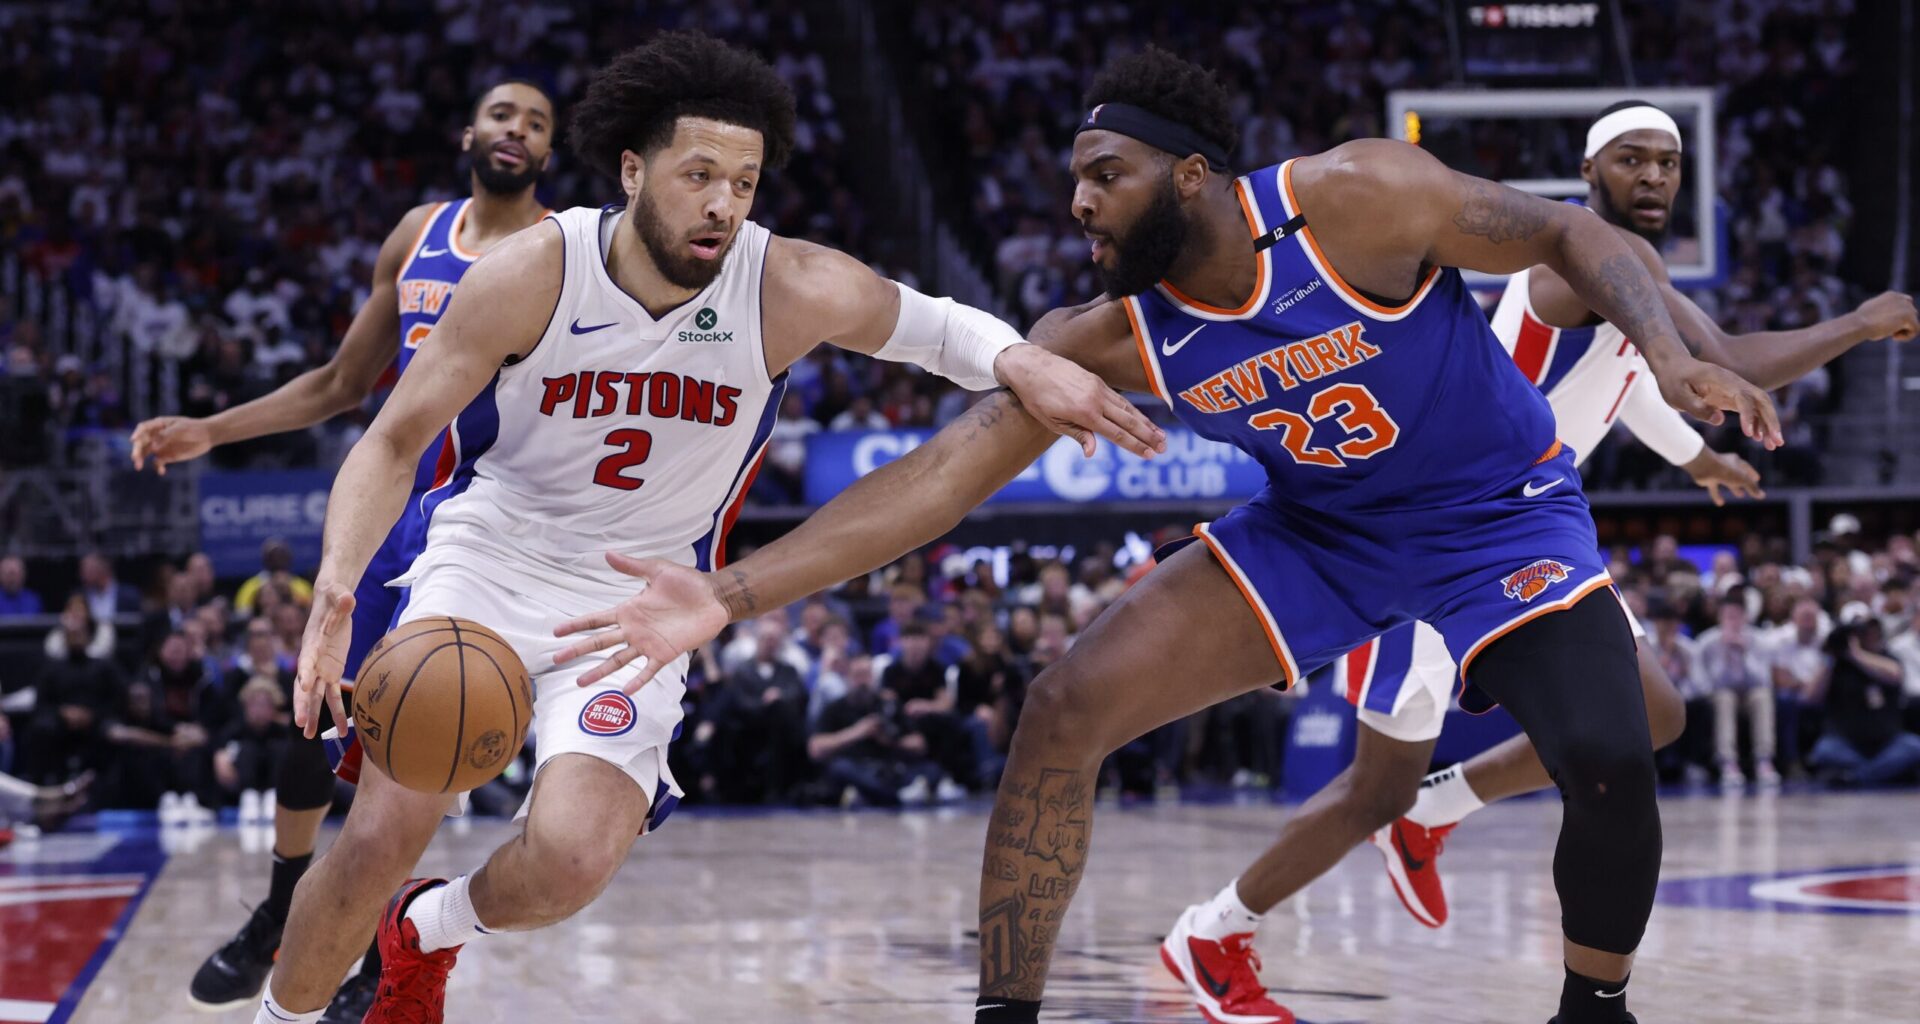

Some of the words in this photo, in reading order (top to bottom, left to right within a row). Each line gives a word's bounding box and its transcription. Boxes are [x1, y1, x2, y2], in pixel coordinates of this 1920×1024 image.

[1506, 4, 1598, 27] TISSOT
[1273, 227, 1285, 241] 12
[398, 279, 451, 315] NEW
[1275, 297, 1295, 315] abu
[1294, 277, 1322, 303] dhabi
[678, 331, 733, 342] StockX
[539, 370, 743, 427] PISTONS
[1247, 382, 1400, 468] 23
[592, 428, 653, 491] 2
[1116, 462, 1228, 498] CLUB
[588, 711, 623, 726] PISTONS
[592, 704, 627, 717] DETROIT
